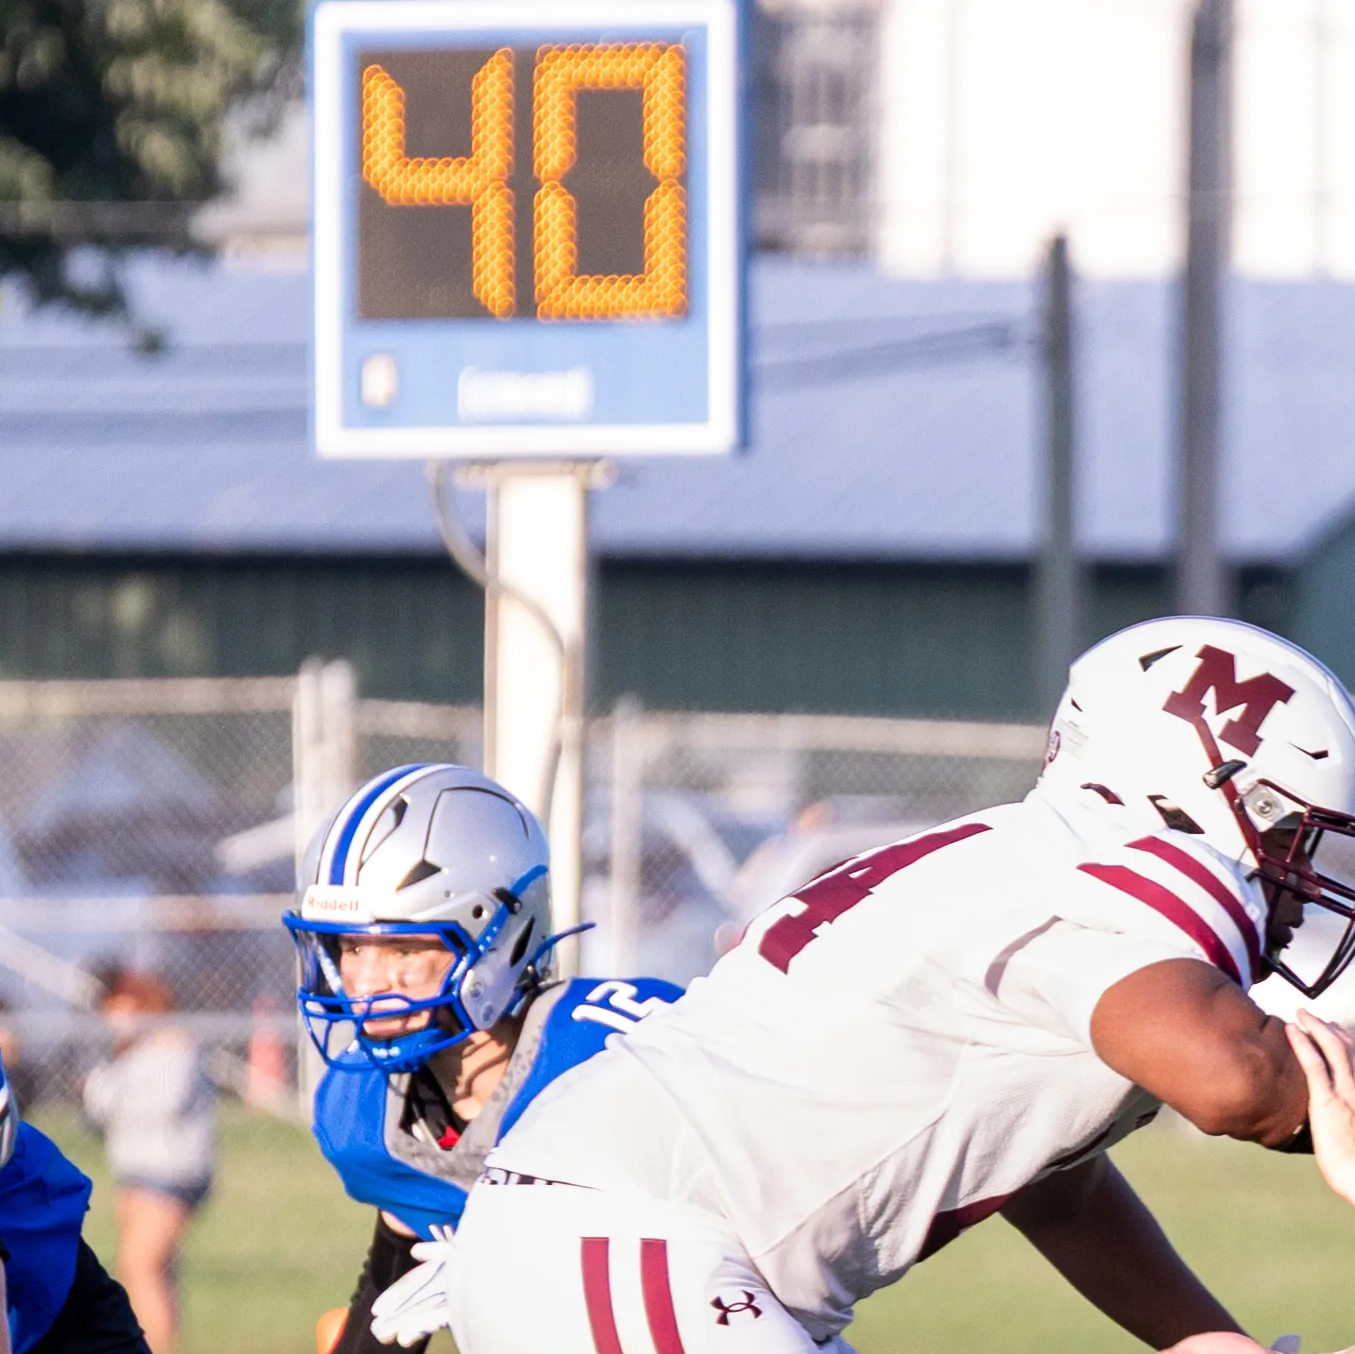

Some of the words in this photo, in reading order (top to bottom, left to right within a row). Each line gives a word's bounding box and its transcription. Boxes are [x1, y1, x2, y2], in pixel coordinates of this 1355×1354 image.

[362, 42, 688, 322] 40
[1162, 643, 1297, 758] M
[571, 980, 658, 1034] 12
